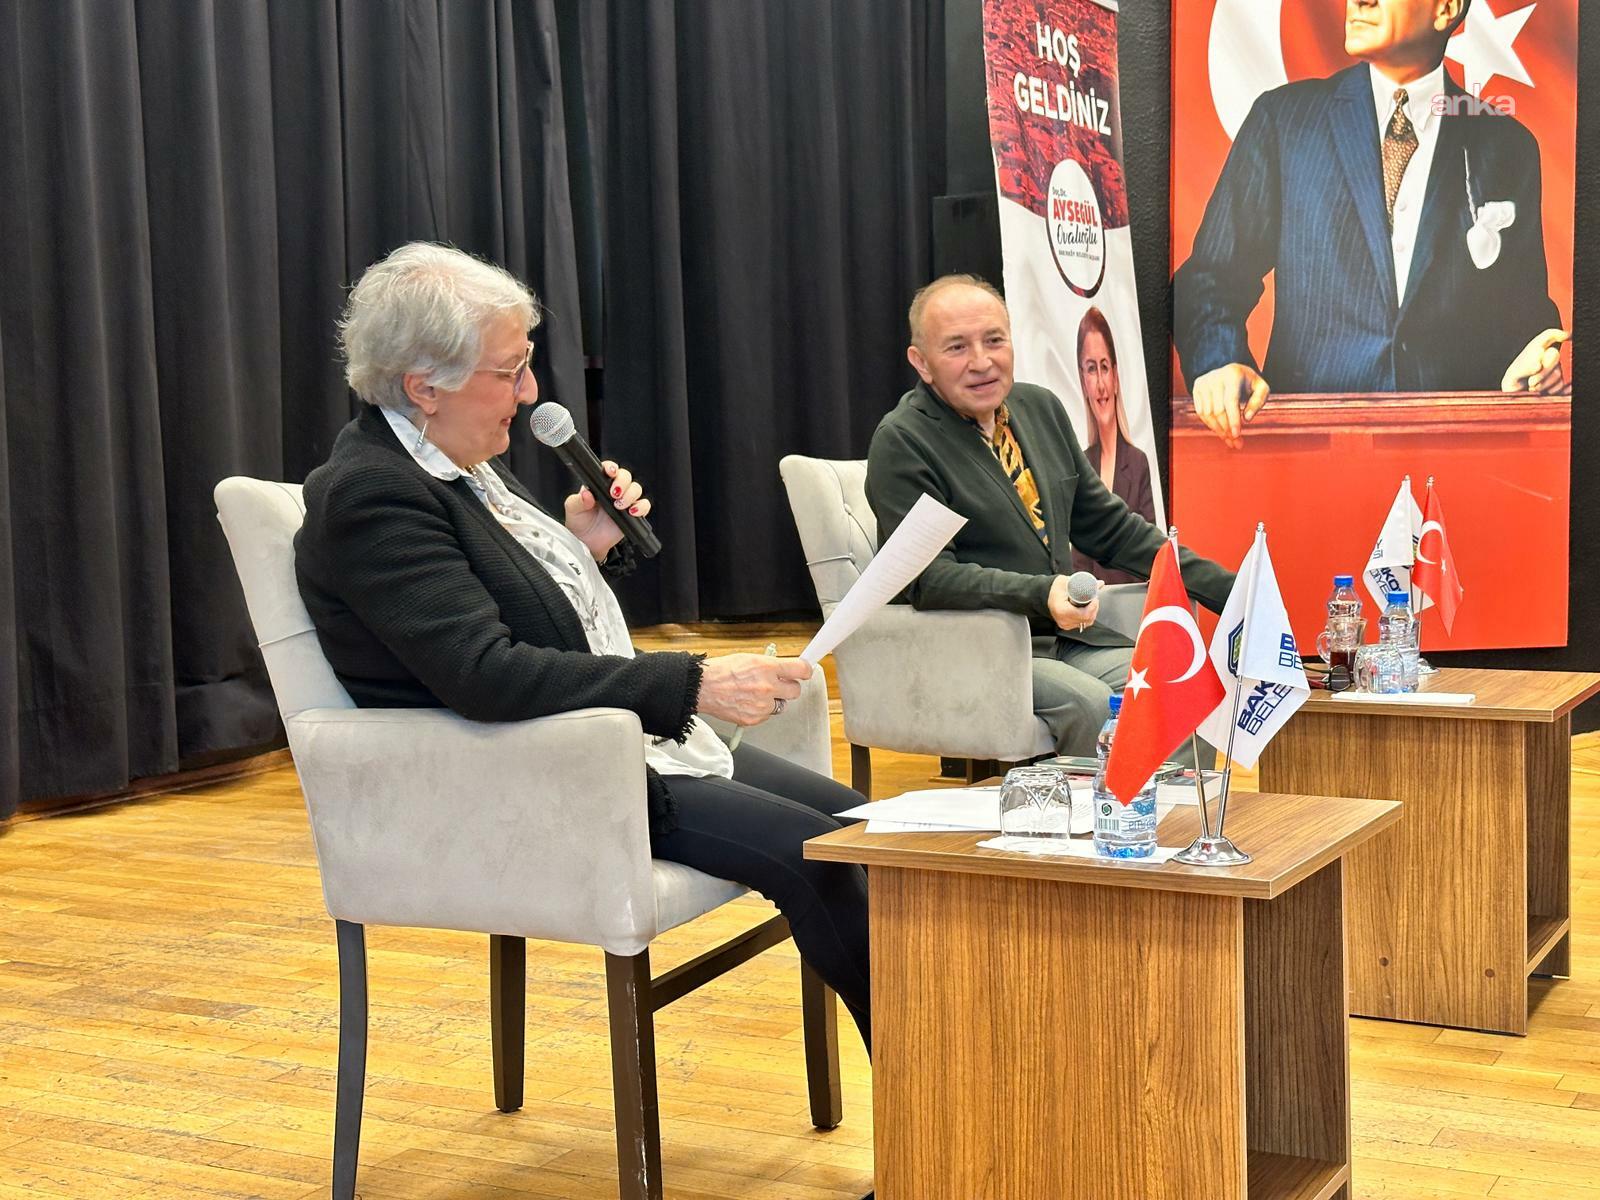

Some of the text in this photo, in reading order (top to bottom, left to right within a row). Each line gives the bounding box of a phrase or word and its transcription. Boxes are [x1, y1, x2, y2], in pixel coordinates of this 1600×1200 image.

[1036, 21, 1081, 78] HOŞ
[1013, 72, 1112, 136] GELDİNİZ
[1053, 199, 1098, 228] AYŞEGÜL
[1246, 684, 1295, 736] BELE
